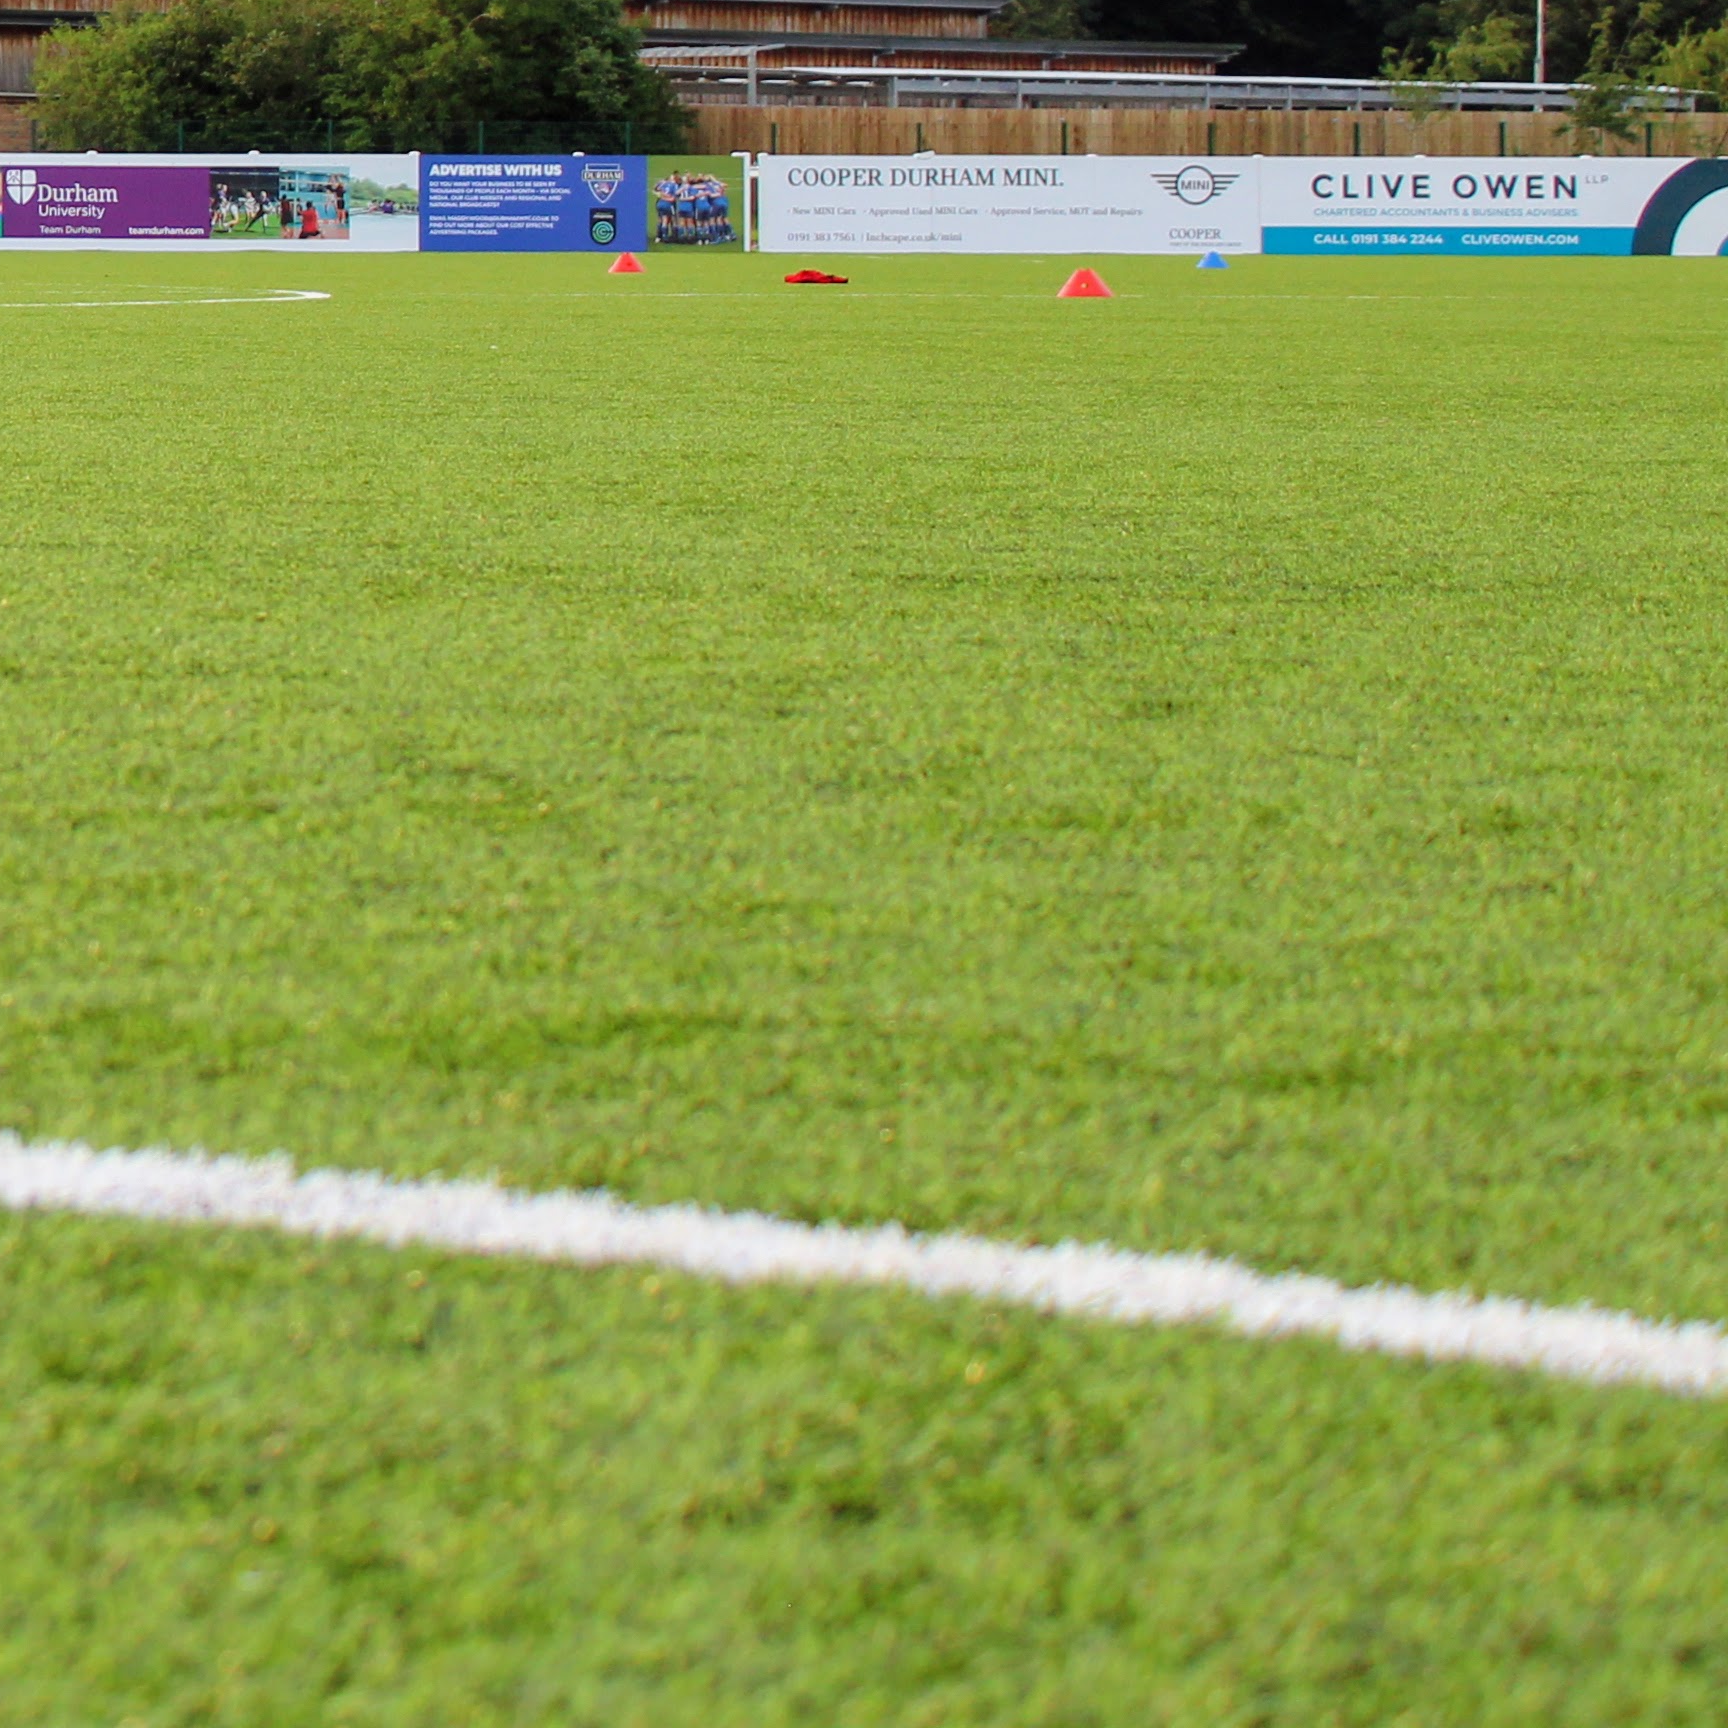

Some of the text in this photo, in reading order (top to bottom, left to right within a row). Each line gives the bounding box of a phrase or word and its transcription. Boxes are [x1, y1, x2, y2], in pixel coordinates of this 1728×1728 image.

[429, 164, 563, 176] ADVERTISE WITH US
[584, 171, 622, 181] DURHAM
[787, 168, 1065, 187] COOPER DURHAM MINI.
[1585, 176, 1609, 184] LLP
[1180, 179, 1210, 190] MINI
[1311, 174, 1578, 199] CLIVE OWEN
[37, 183, 119, 203] Durham
[38, 204, 105, 219] University
[792, 208, 856, 216] New MINI Cars
[868, 208, 910, 217] Approved
[935, 207, 957, 215] MINI
[990, 207, 1032, 217] Approved
[1069, 207, 1090, 215] MOT
[1092, 207, 1108, 215] and
[1110, 207, 1143, 217] Repairs
[1314, 208, 1580, 217] CHARTERED ACCOUNTANTS & BUSINESS ADVISERS
[40, 225, 101, 234] Team Durham
[128, 226, 205, 236] teamdurham.com
[1169, 228, 1222, 239] COOPER
[787, 233, 811, 242] 0191
[833, 233, 856, 242] 7561
[1314, 234, 1443, 245] CALL 0191 384 2244
[1461, 234, 1580, 245] CLIVEOWEN.COM
